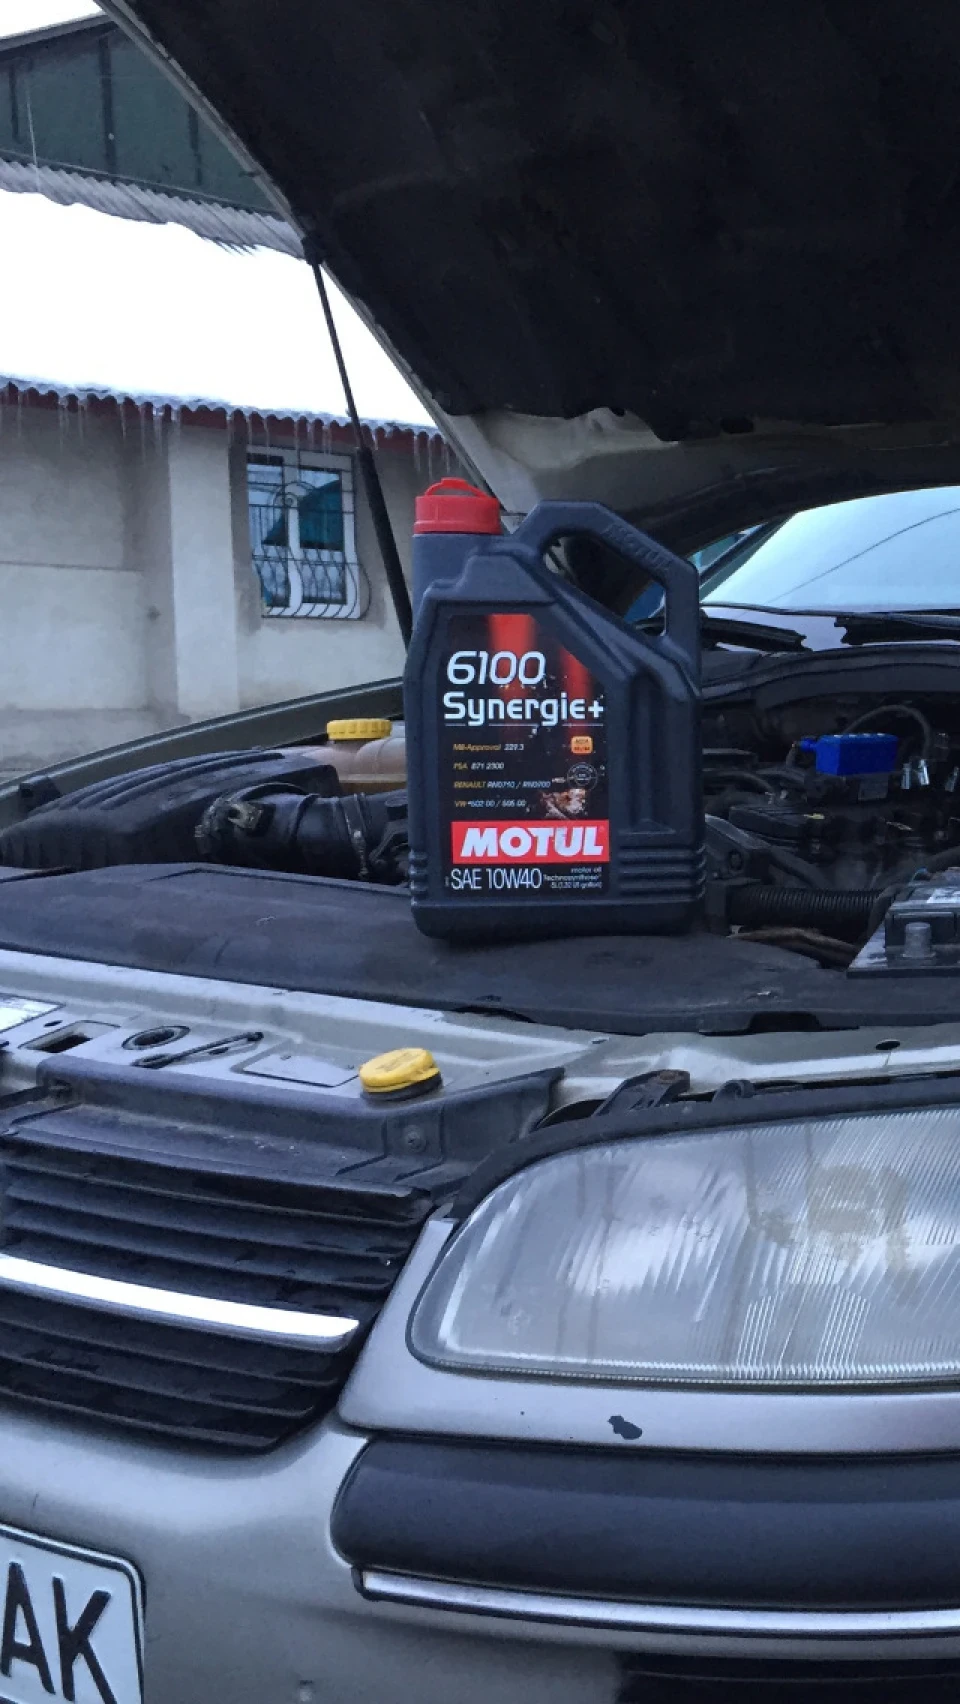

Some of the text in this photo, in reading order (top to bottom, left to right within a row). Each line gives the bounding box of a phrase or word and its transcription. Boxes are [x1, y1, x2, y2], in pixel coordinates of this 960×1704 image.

[446, 650, 547, 686] 6100
[443, 691, 604, 727] Synergie+
[453, 781, 486, 789] RENAULT
[460, 827, 604, 857] MOTUL
[450, 868, 482, 891] SAE
[485, 868, 542, 890] 10W40
[0, 1561, 117, 1704] AK
